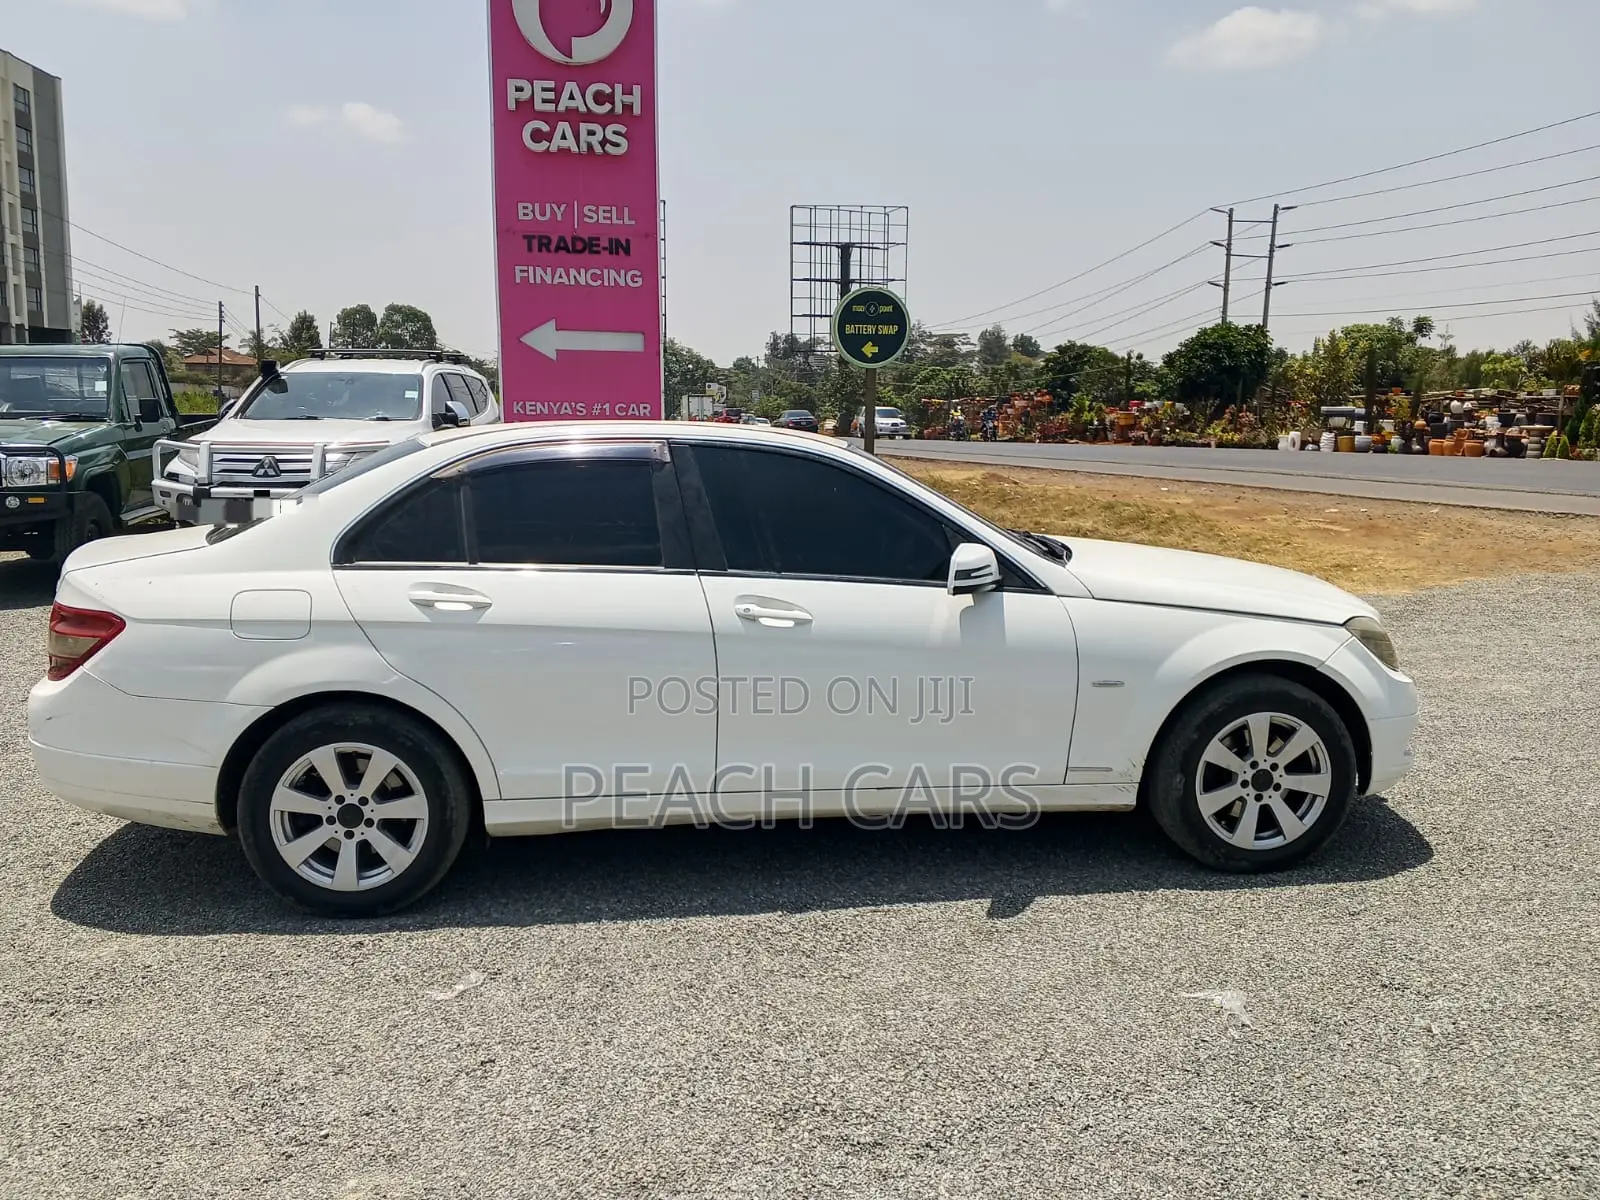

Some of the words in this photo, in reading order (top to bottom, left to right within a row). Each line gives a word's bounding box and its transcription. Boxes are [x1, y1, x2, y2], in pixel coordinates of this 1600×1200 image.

[506, 78, 641, 116] PEACH
[522, 120, 629, 156] CARS
[517, 202, 567, 221] BUY
[583, 205, 636, 225] SELL
[522, 234, 631, 256] TRADE-IN
[514, 265, 643, 288] FINANCING
[845, 324, 877, 335] BATTERY
[877, 324, 899, 335] SWAP
[513, 401, 587, 416] KENYA'S
[592, 403, 610, 416] #1
[615, 403, 651, 417] CAR
